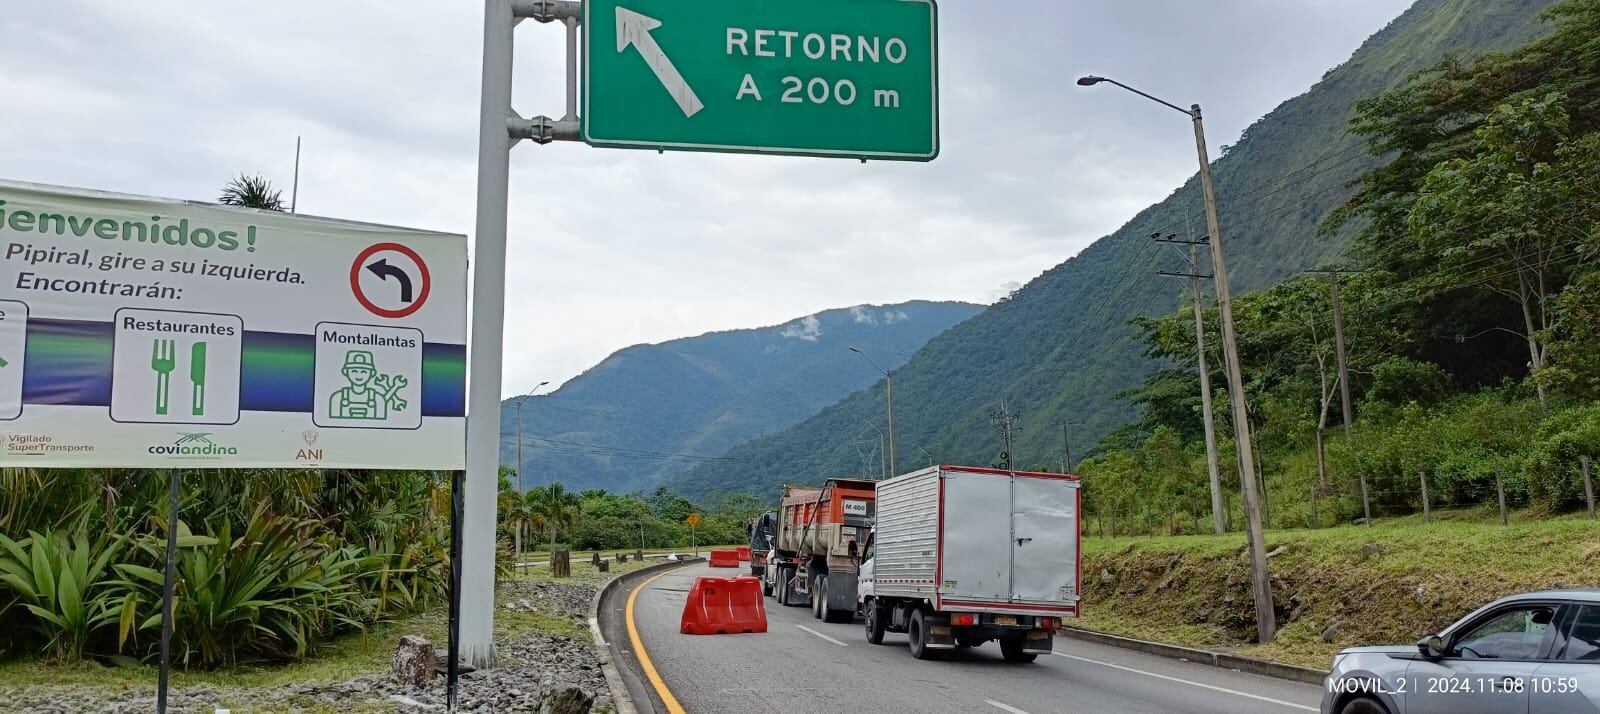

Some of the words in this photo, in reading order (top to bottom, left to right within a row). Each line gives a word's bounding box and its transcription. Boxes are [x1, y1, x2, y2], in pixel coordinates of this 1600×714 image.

[726, 27, 908, 64] RETORNO
[735, 73, 762, 101] A
[780, 76, 857, 105] 200
[873, 88, 900, 108] m
[0, 200, 257, 252] ienvenidos!
[5, 243, 93, 269] Pipiral,
[98, 252, 146, 271] gire
[151, 259, 165, 272] a
[169, 261, 196, 275] su
[201, 259, 306, 284] izquierda.
[16, 272, 183, 301] Encontrarán:
[123, 317, 235, 337] Restaurantes
[323, 331, 416, 349] Montallantas
[8, 434, 52, 444] Vigilado
[8, 443, 95, 453] SuperTransporte
[148, 443, 238, 455] coviandina
[295, 449, 323, 460] ANI
